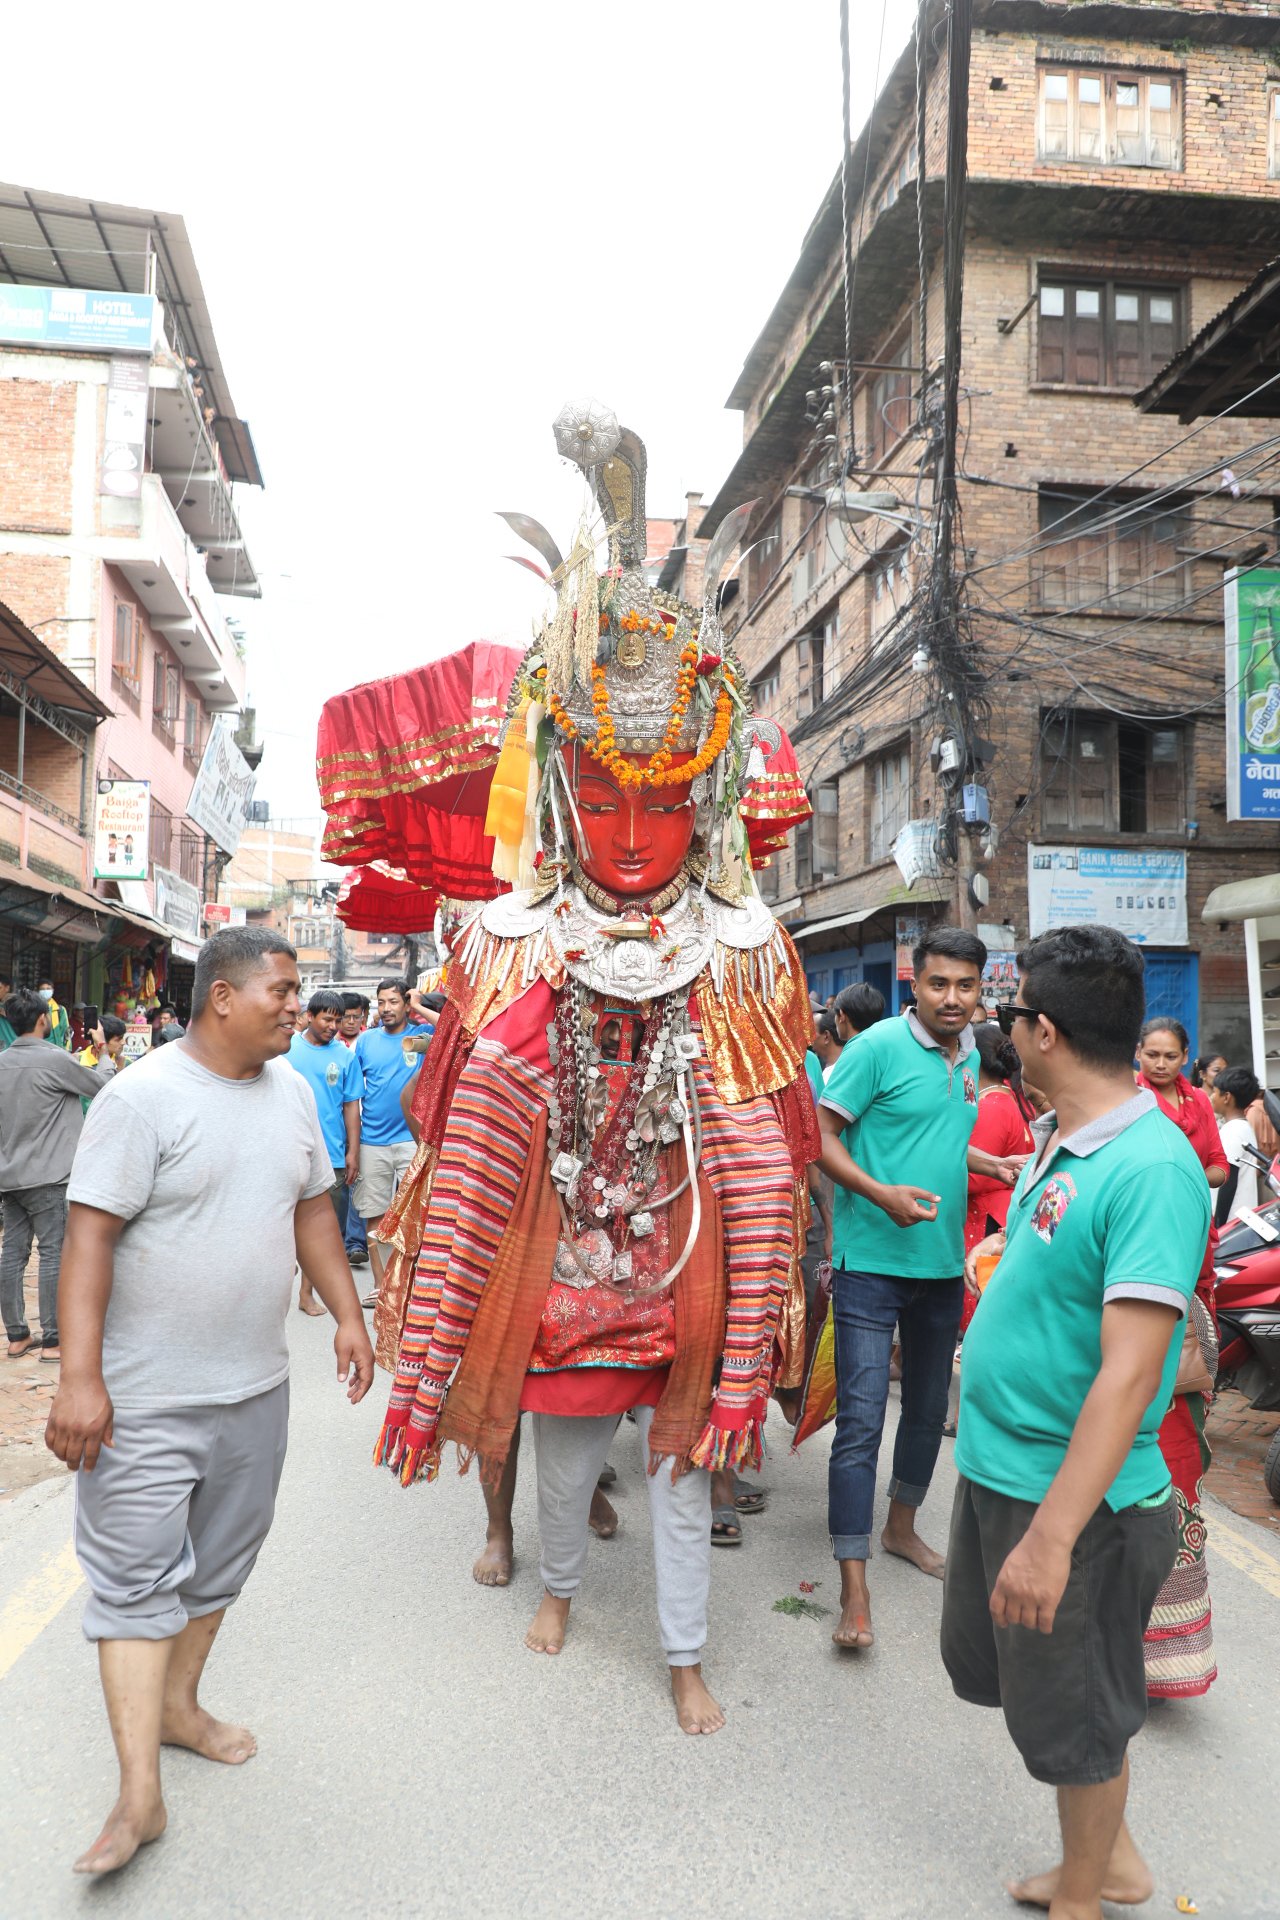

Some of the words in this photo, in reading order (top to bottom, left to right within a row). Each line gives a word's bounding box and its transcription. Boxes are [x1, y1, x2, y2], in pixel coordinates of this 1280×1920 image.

[92, 300, 135, 316] HOTEL
[1249, 697, 1280, 742] TUBORG
[106, 796, 139, 808] Baiga
[101, 808, 143, 821] Rooftop
[98, 820, 145, 832] Restaurant
[1110, 854, 1143, 867] MOBILE
[1145, 854, 1182, 868] SERVICE
[124, 1035, 148, 1047] GA
